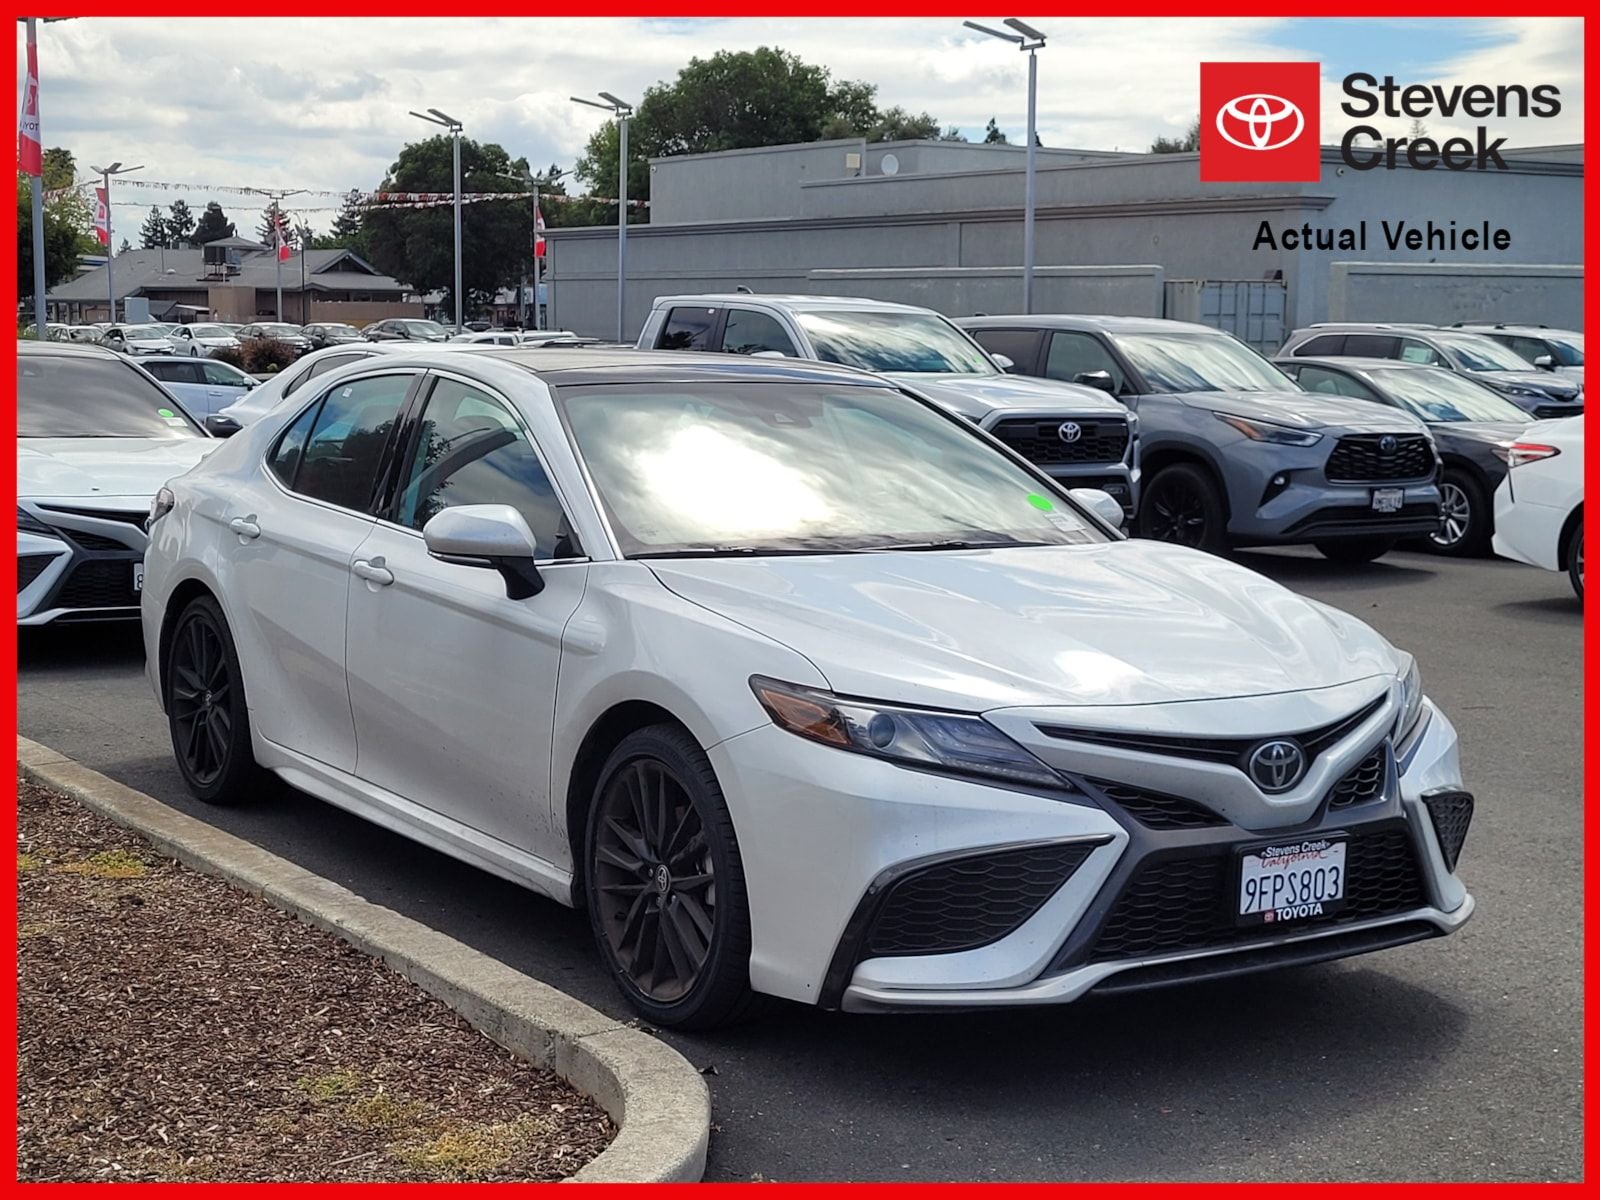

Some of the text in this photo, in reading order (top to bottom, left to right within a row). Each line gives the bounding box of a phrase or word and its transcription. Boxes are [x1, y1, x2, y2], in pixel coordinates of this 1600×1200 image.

[1266, 840, 1327, 857] Stevens Creek
[1261, 851, 1328, 870] California
[1245, 866, 1340, 912] 9FPS803
[1276, 902, 1323, 921] TOYOTA
